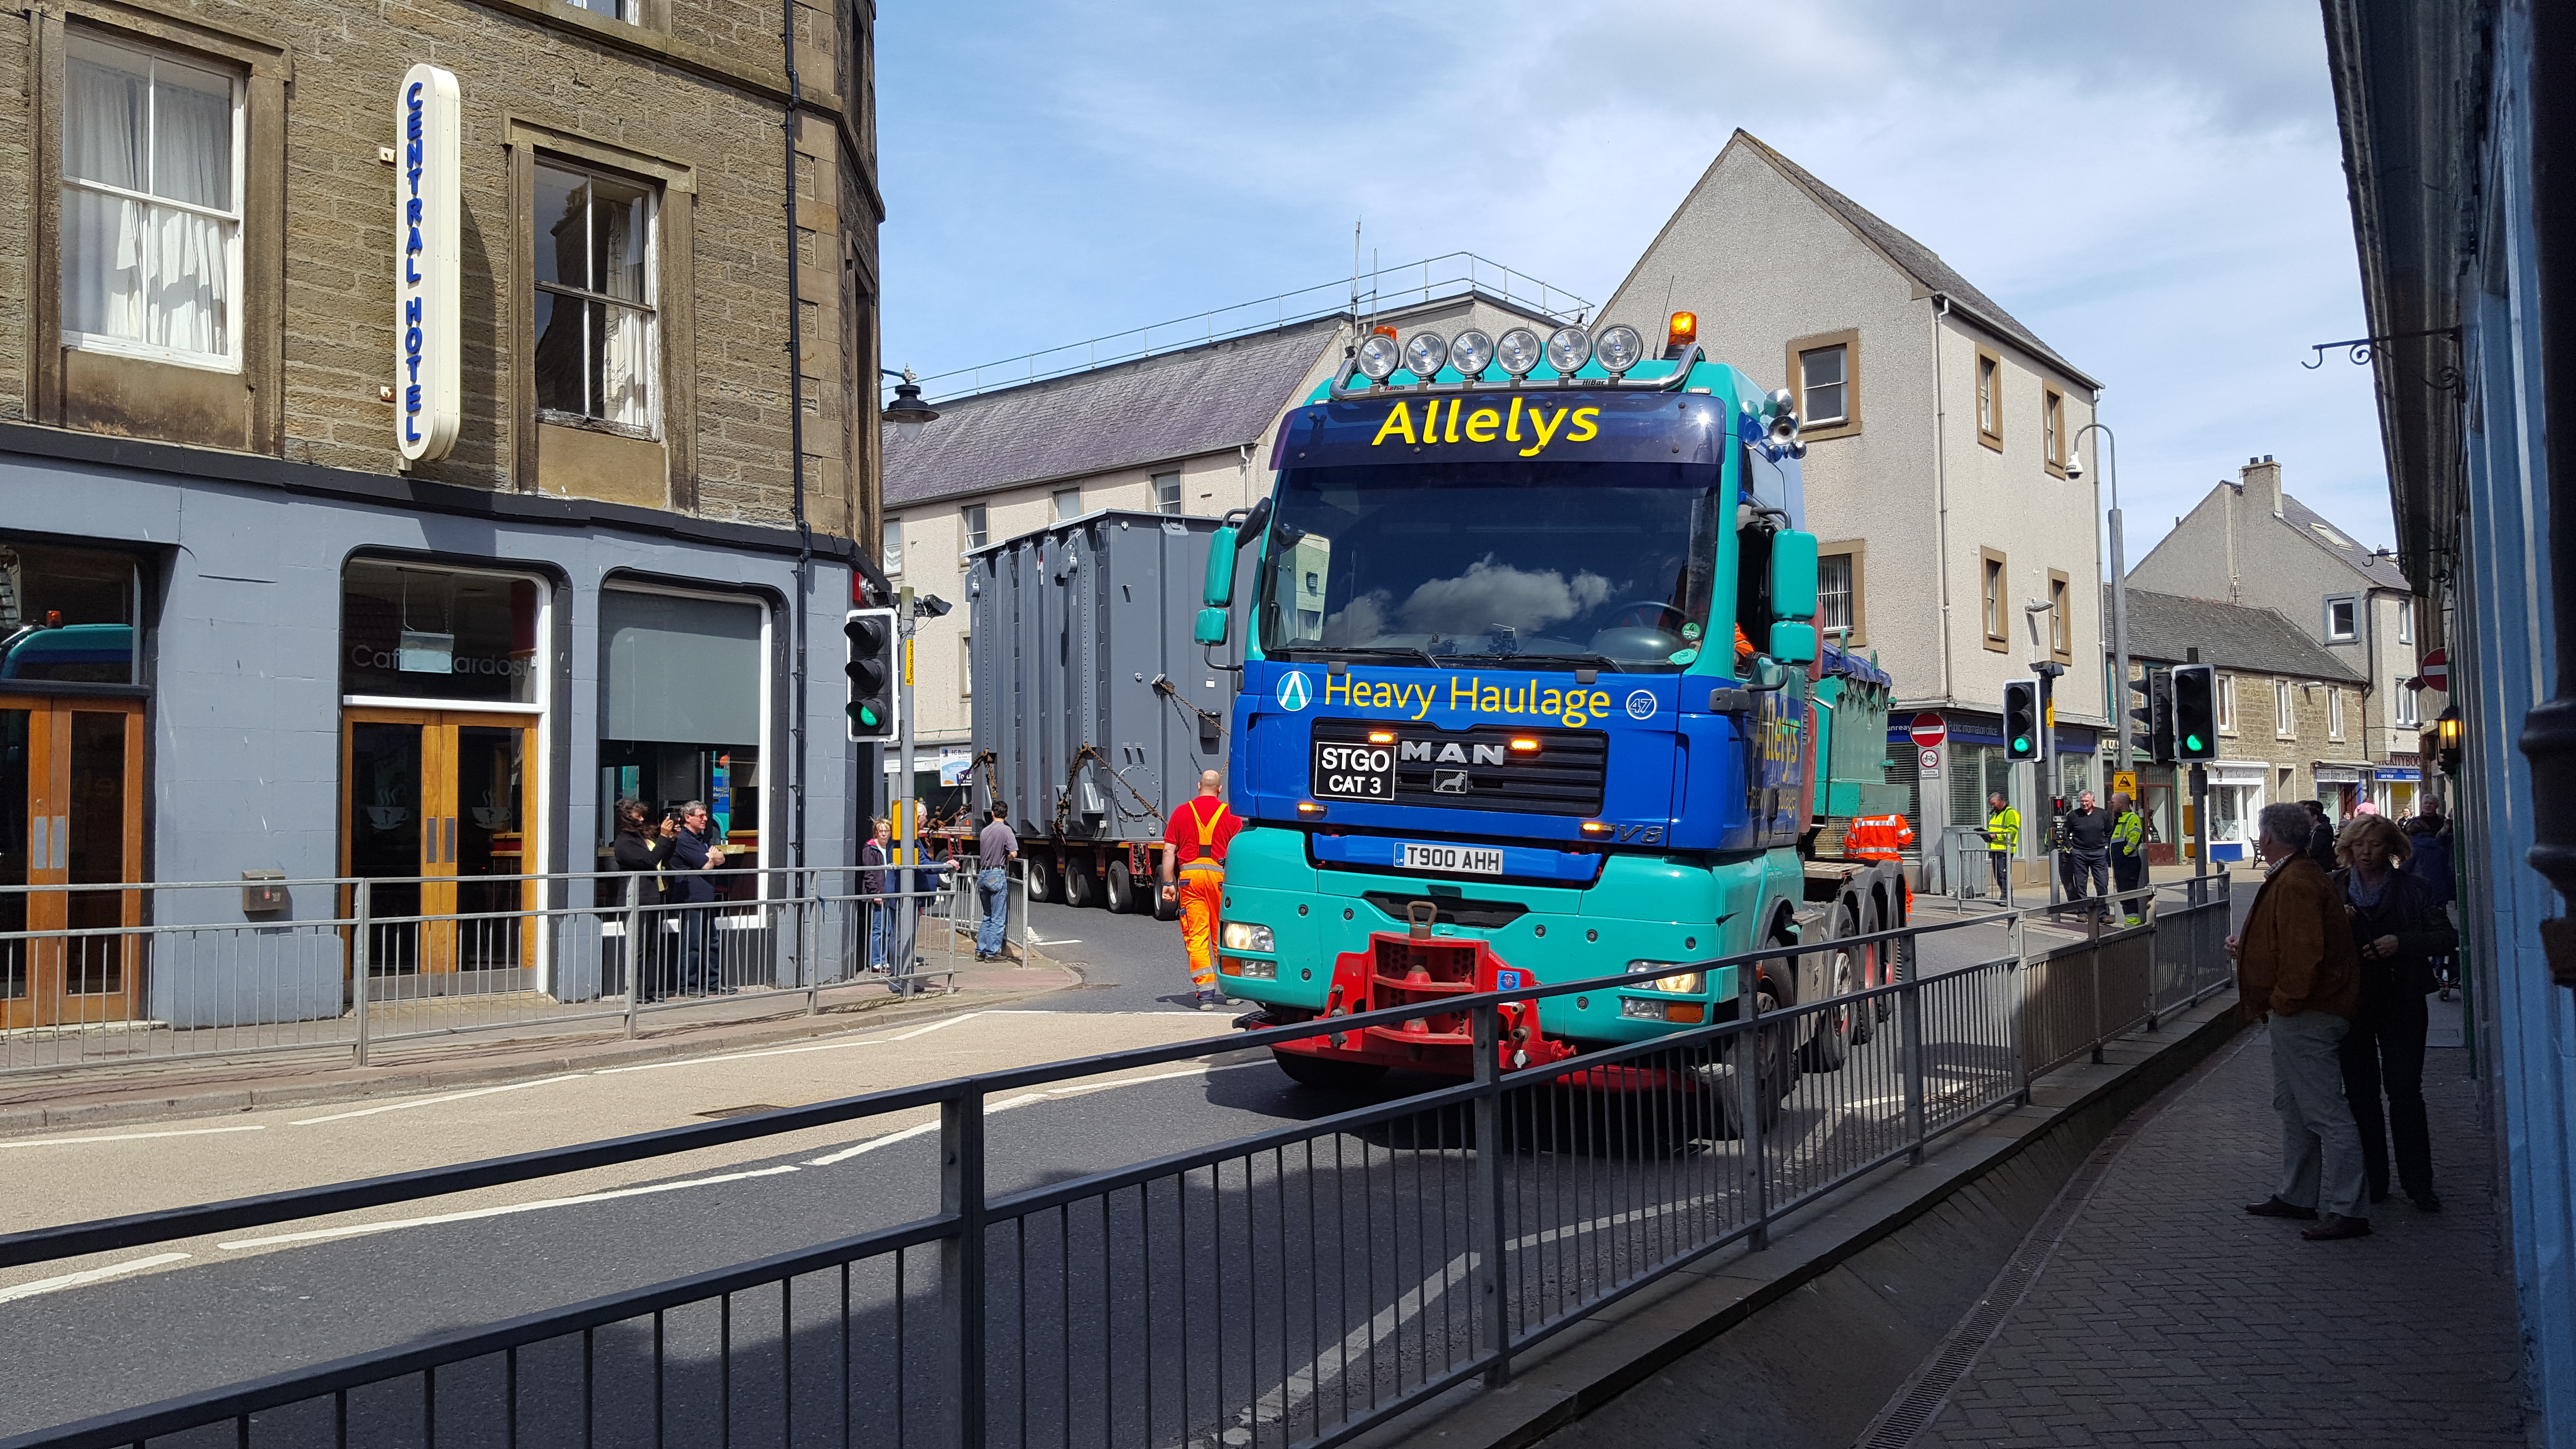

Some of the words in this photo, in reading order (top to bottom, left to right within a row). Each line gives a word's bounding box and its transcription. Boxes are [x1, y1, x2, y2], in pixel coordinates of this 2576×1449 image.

[406, 81, 423, 283] CENTRAL
[405, 296, 423, 442] HOTEL
[1371, 396, 1600, 457] Allelys
[352, 644, 400, 669] Caf
[453, 655, 530, 676] ardosi
[1324, 673, 1436, 720] Heavy
[1450, 676, 1610, 728] Haulage
[1629, 698, 1653, 713] 47
[1401, 741, 1504, 765] MAN
[1754, 695, 1798, 782] Allelys
[1321, 747, 1390, 773] STGO
[1329, 774, 1366, 793] CAT
[1369, 777, 1381, 794] 3
[1777, 789, 1796, 819] aulage
[1618, 824, 1664, 843] V8
[1407, 846, 1456, 868] T900
[1462, 850, 1500, 871] AHH
